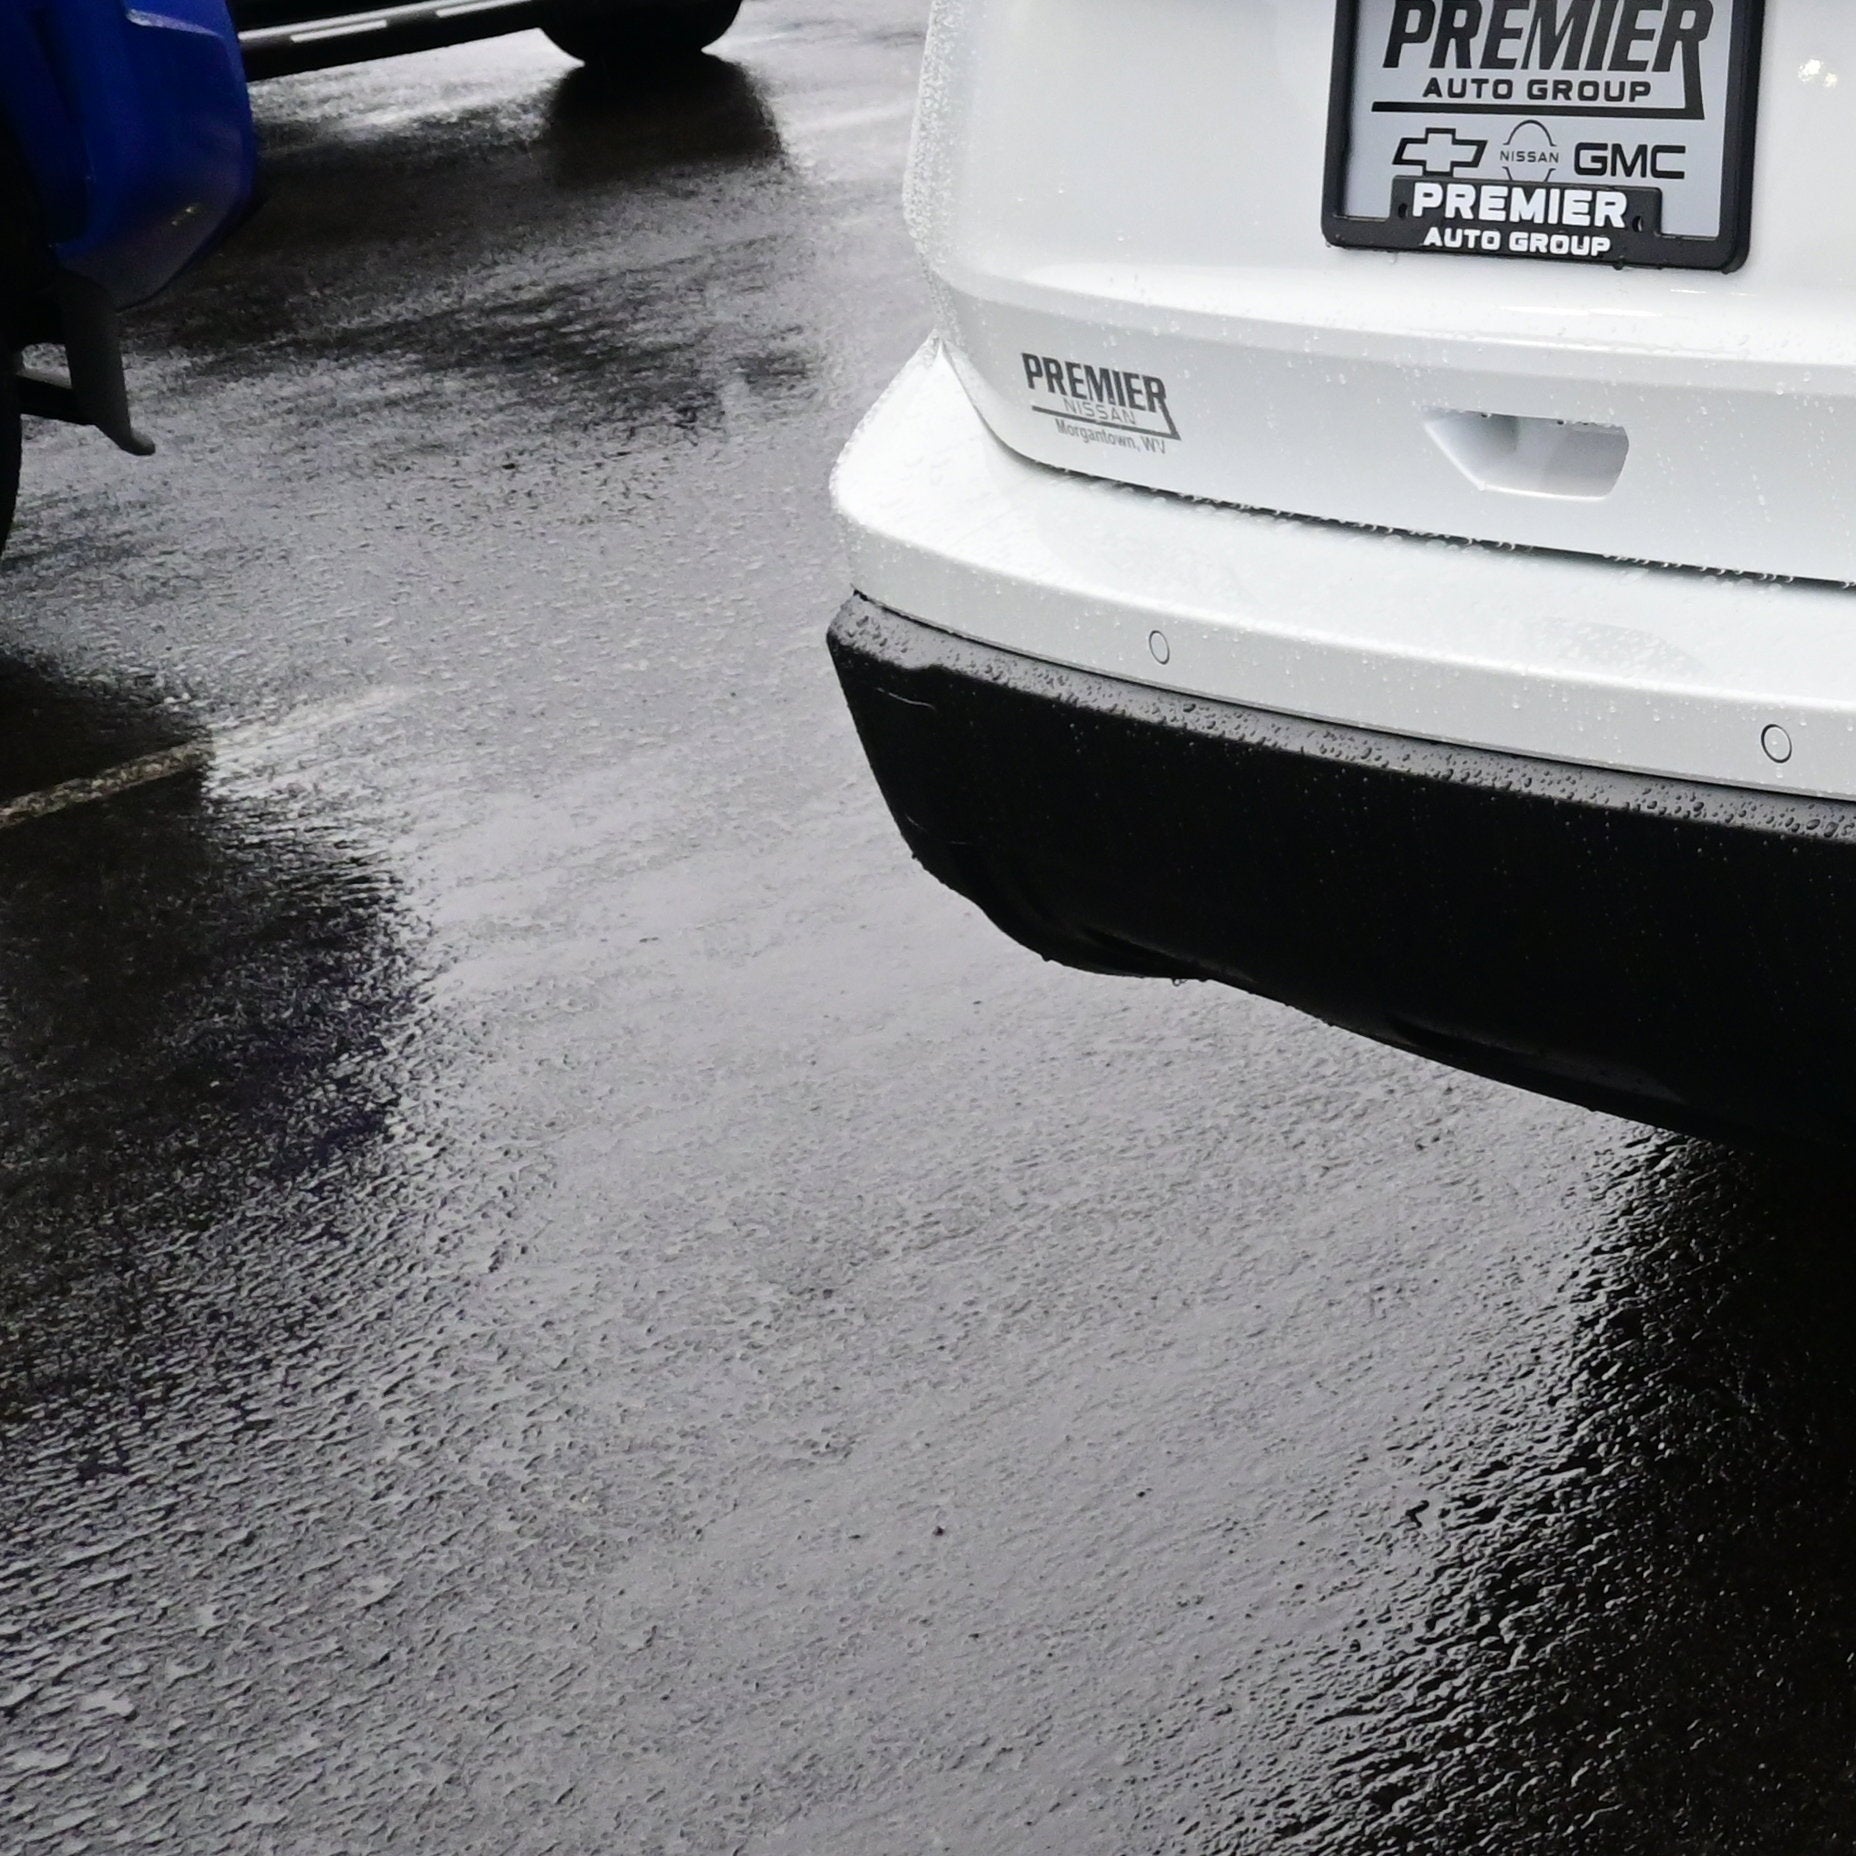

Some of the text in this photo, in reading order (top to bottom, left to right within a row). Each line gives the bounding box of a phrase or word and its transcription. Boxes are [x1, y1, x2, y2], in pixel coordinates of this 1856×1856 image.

[1422, 77, 1652, 103] AUTO GROUP
[1499, 142, 1687, 180] NISSAN GMC
[1411, 181, 1628, 229] PREMIER
[1422, 226, 1612, 257] AUTO GROUP
[1020, 352, 1167, 413] PREMIER
[1062, 397, 1137, 425] NISSAN
[1054, 418, 1166, 455] Morgantown, WV
